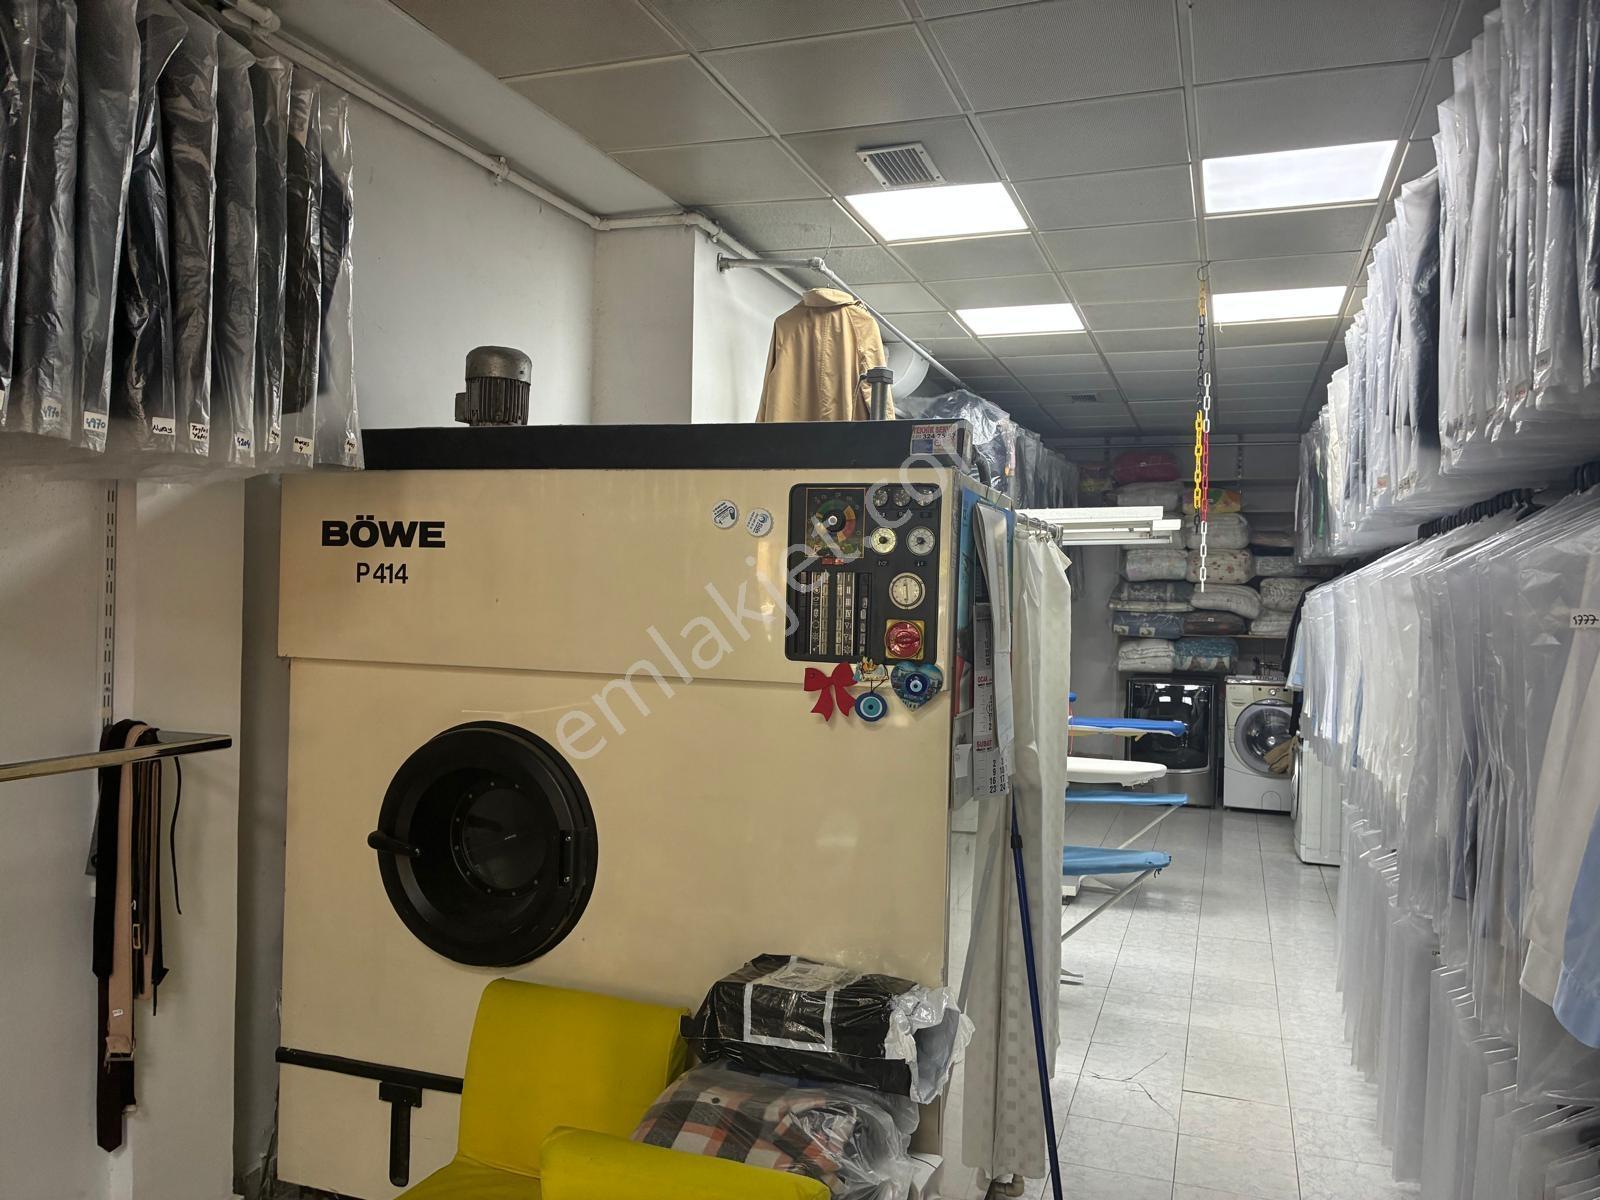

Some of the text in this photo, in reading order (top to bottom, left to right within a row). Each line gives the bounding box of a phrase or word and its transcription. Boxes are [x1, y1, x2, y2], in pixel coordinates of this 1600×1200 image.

[86, 417, 106, 429] 4970
[322, 515, 446, 548] BÖWE
[356, 562, 408, 584] P 414
[989, 784, 997, 794] 23
